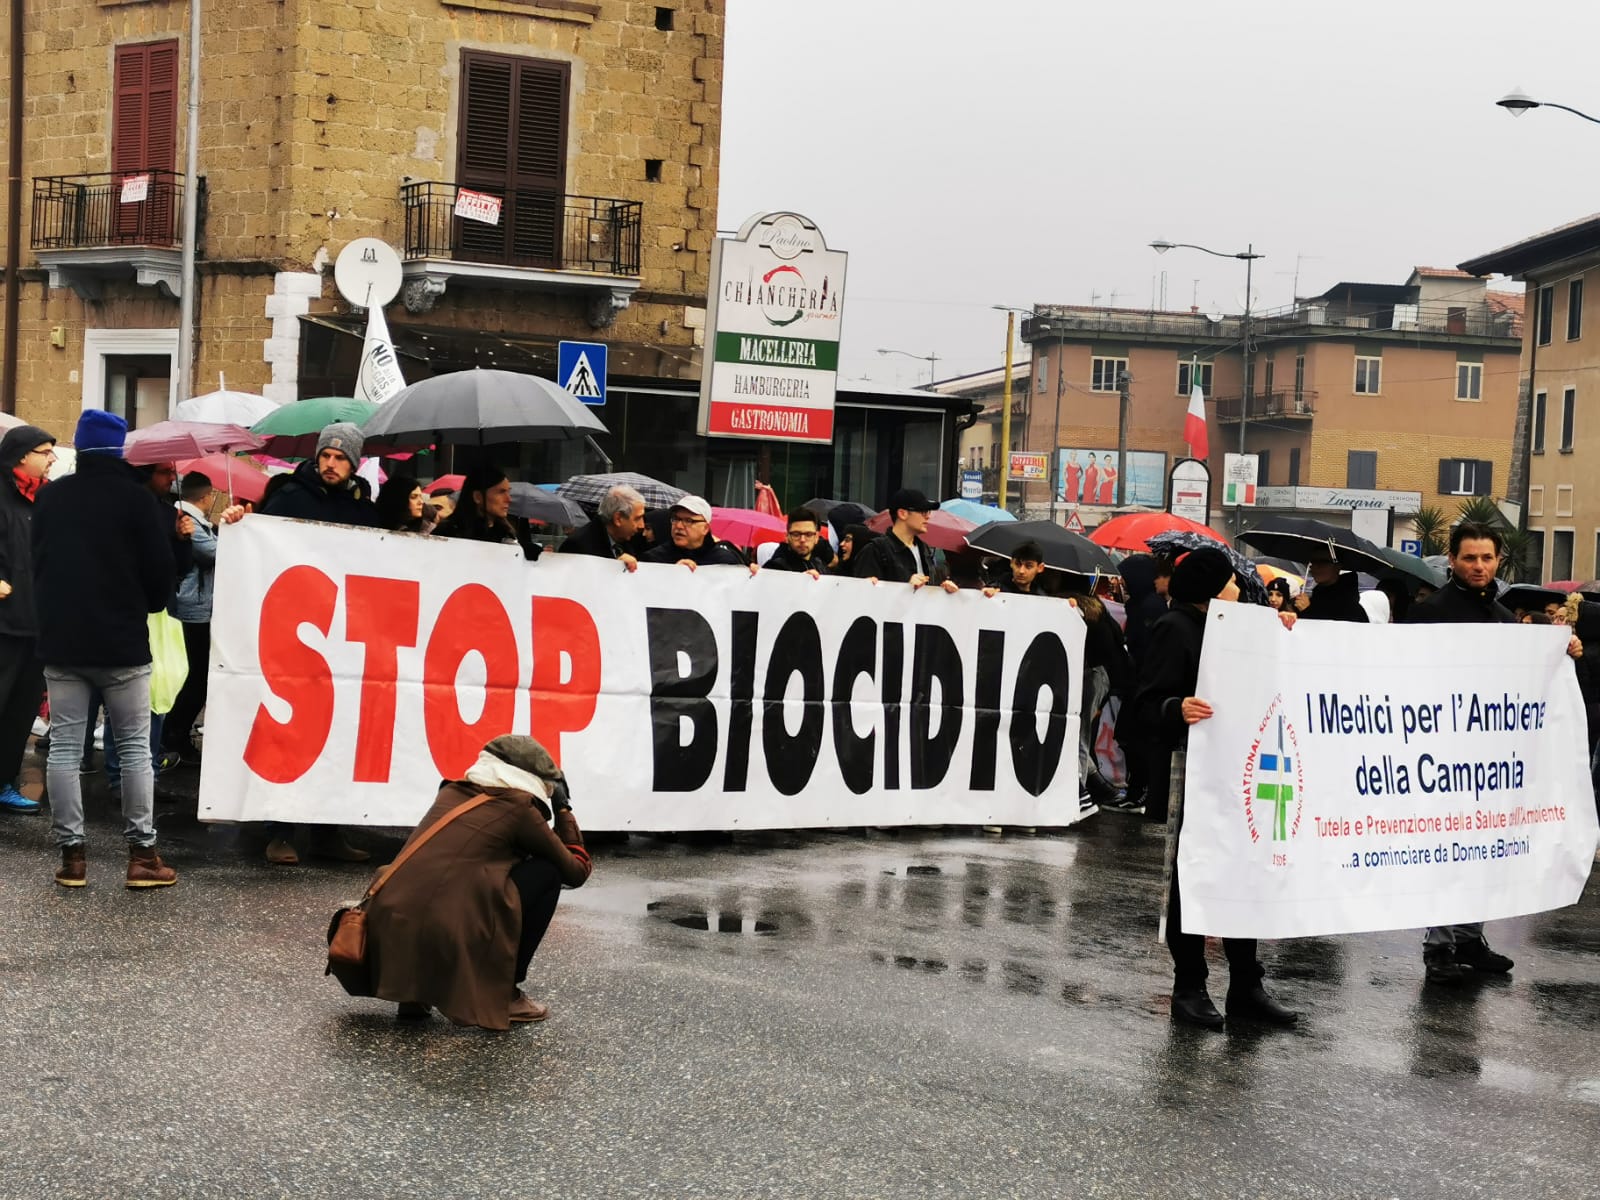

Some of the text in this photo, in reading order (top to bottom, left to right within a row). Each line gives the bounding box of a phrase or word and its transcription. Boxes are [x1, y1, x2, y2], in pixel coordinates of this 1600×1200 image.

[763, 228, 811, 247] Paolino
[371, 344, 393, 366] NO
[739, 336, 816, 366] MACELLERIA
[733, 374, 810, 399] HAMBURGERIA
[731, 408, 809, 433] GASTRONOMIA
[1012, 455, 1045, 468] PIZZERIA
[1325, 490, 1384, 508] Zaccaria
[1405, 542, 1417, 554] P
[242, 564, 1070, 797] STOP BIOCIDIO
[1306, 692, 1313, 734] I
[1319, 692, 1393, 734] Medici
[1401, 701, 1443, 744] per
[1356, 751, 1524, 801] della Campania
[1315, 815, 1350, 838] Tutela
[1354, 820, 1363, 836] e
[1366, 814, 1442, 836] Prevenzione
[1445, 812, 1472, 832] della
[1475, 809, 1507, 830] Salute
[1364, 845, 1431, 867] cominciare
[1434, 844, 1448, 863] da
[1452, 842, 1488, 862] Donne
